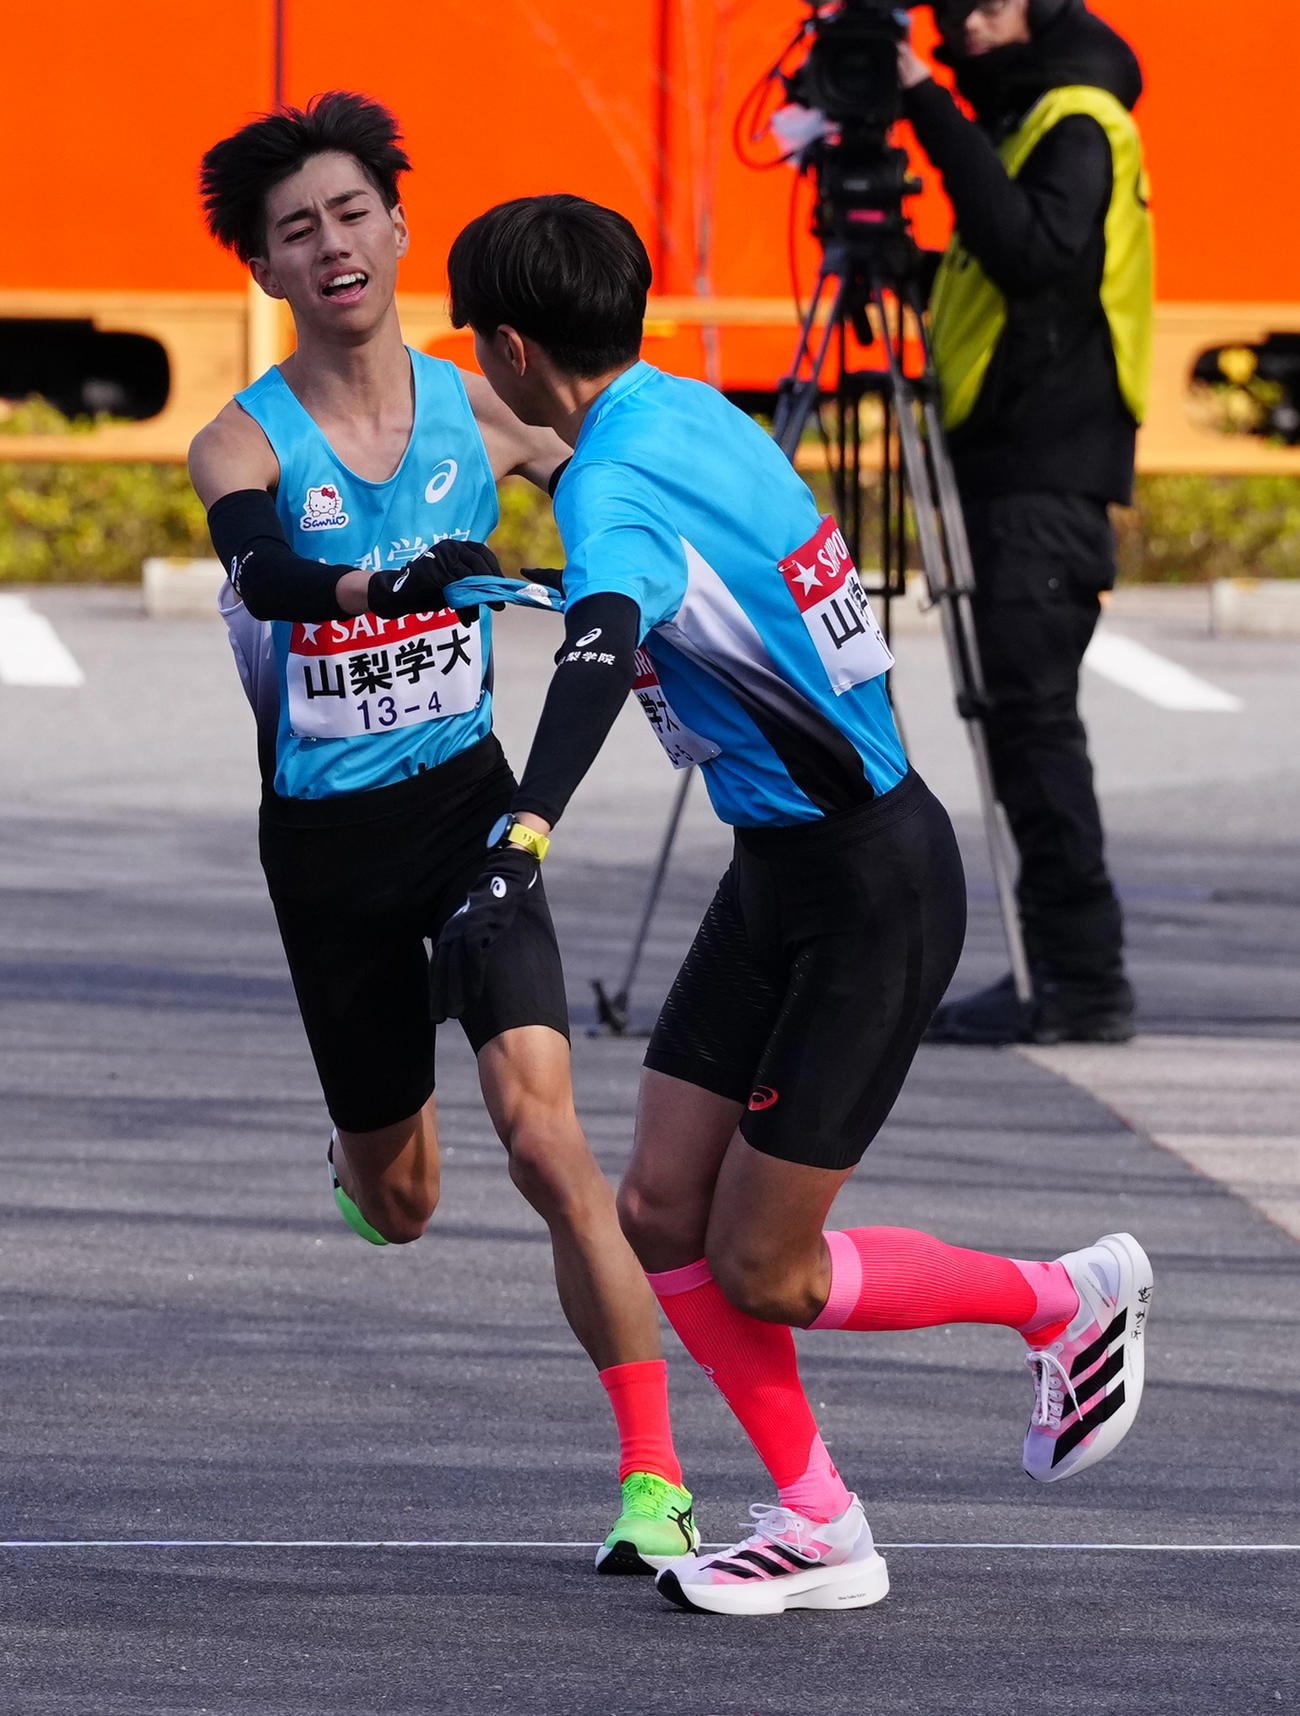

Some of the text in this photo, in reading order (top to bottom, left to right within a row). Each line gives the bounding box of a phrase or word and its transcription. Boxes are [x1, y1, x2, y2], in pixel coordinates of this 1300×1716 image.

[302, 515, 346, 529] Sanrio
[303, 629, 472, 700] 山梨学大
[357, 690, 442, 730] 13-4
